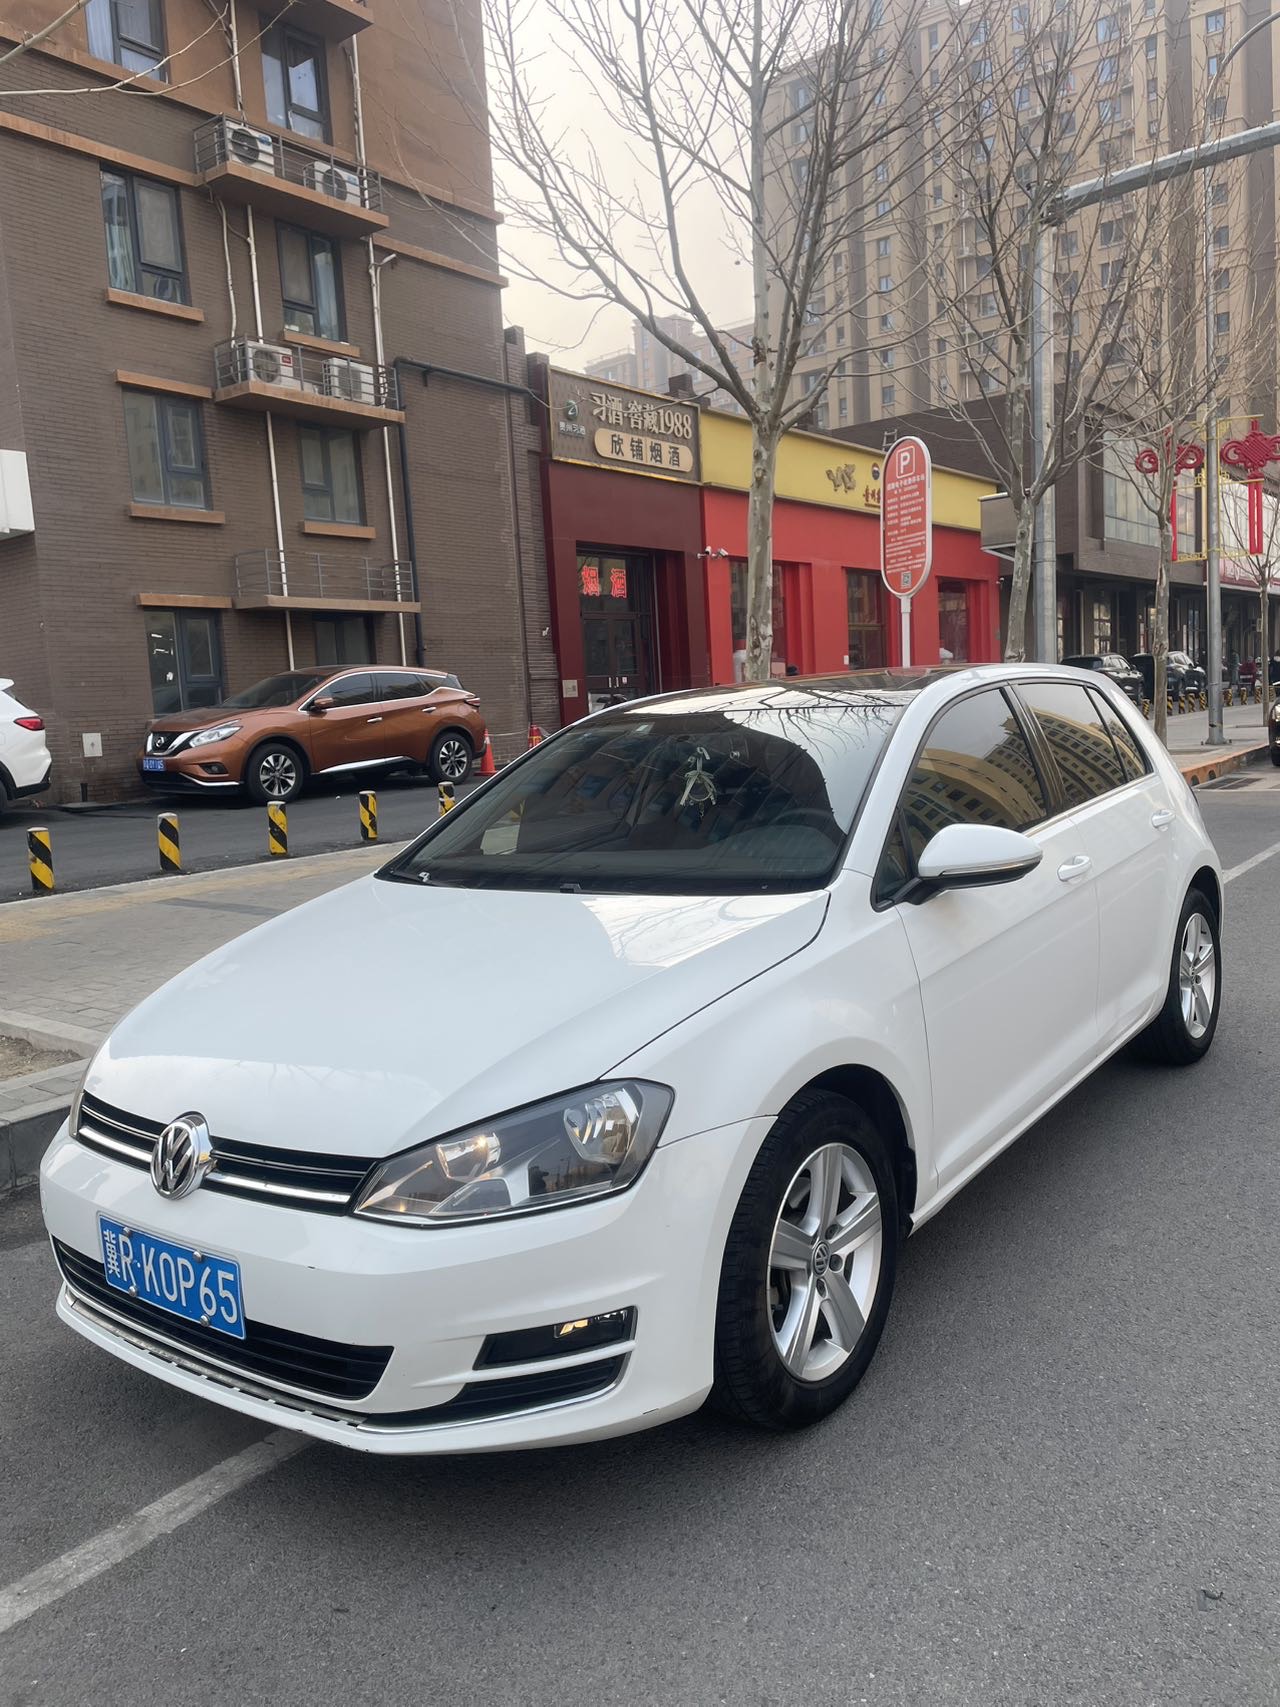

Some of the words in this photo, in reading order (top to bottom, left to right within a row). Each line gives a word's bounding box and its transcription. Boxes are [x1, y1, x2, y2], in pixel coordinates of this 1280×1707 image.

[610, 433, 681, 468] 欣铺烟酒
[900, 451, 911, 474] P
